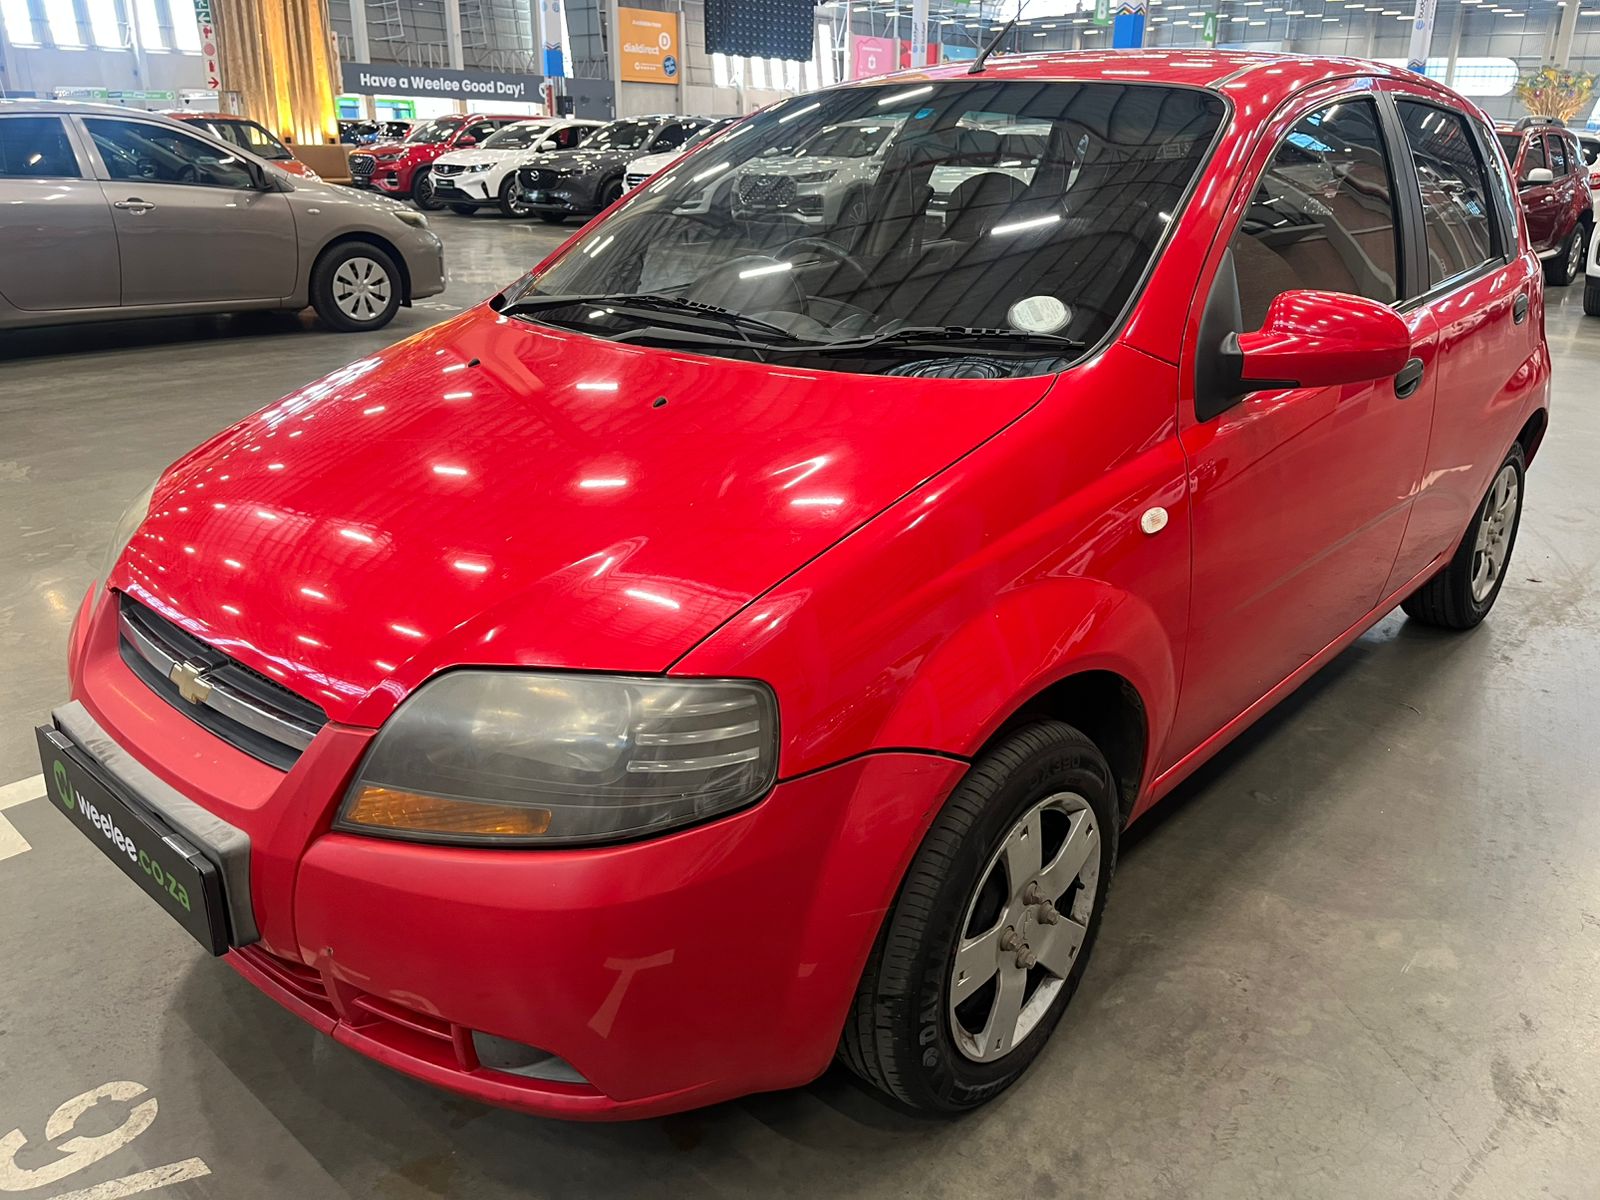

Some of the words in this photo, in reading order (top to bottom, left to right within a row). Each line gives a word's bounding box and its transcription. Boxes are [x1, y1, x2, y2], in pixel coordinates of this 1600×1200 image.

[1204, 17, 1214, 37] A
[359, 72, 397, 88] Have
[400, 77, 409, 89] a
[410, 76, 460, 92] Weelee
[461, 79, 495, 94] Good
[497, 81, 525, 98] Day!
[75, 790, 191, 912] weelee.co.za
